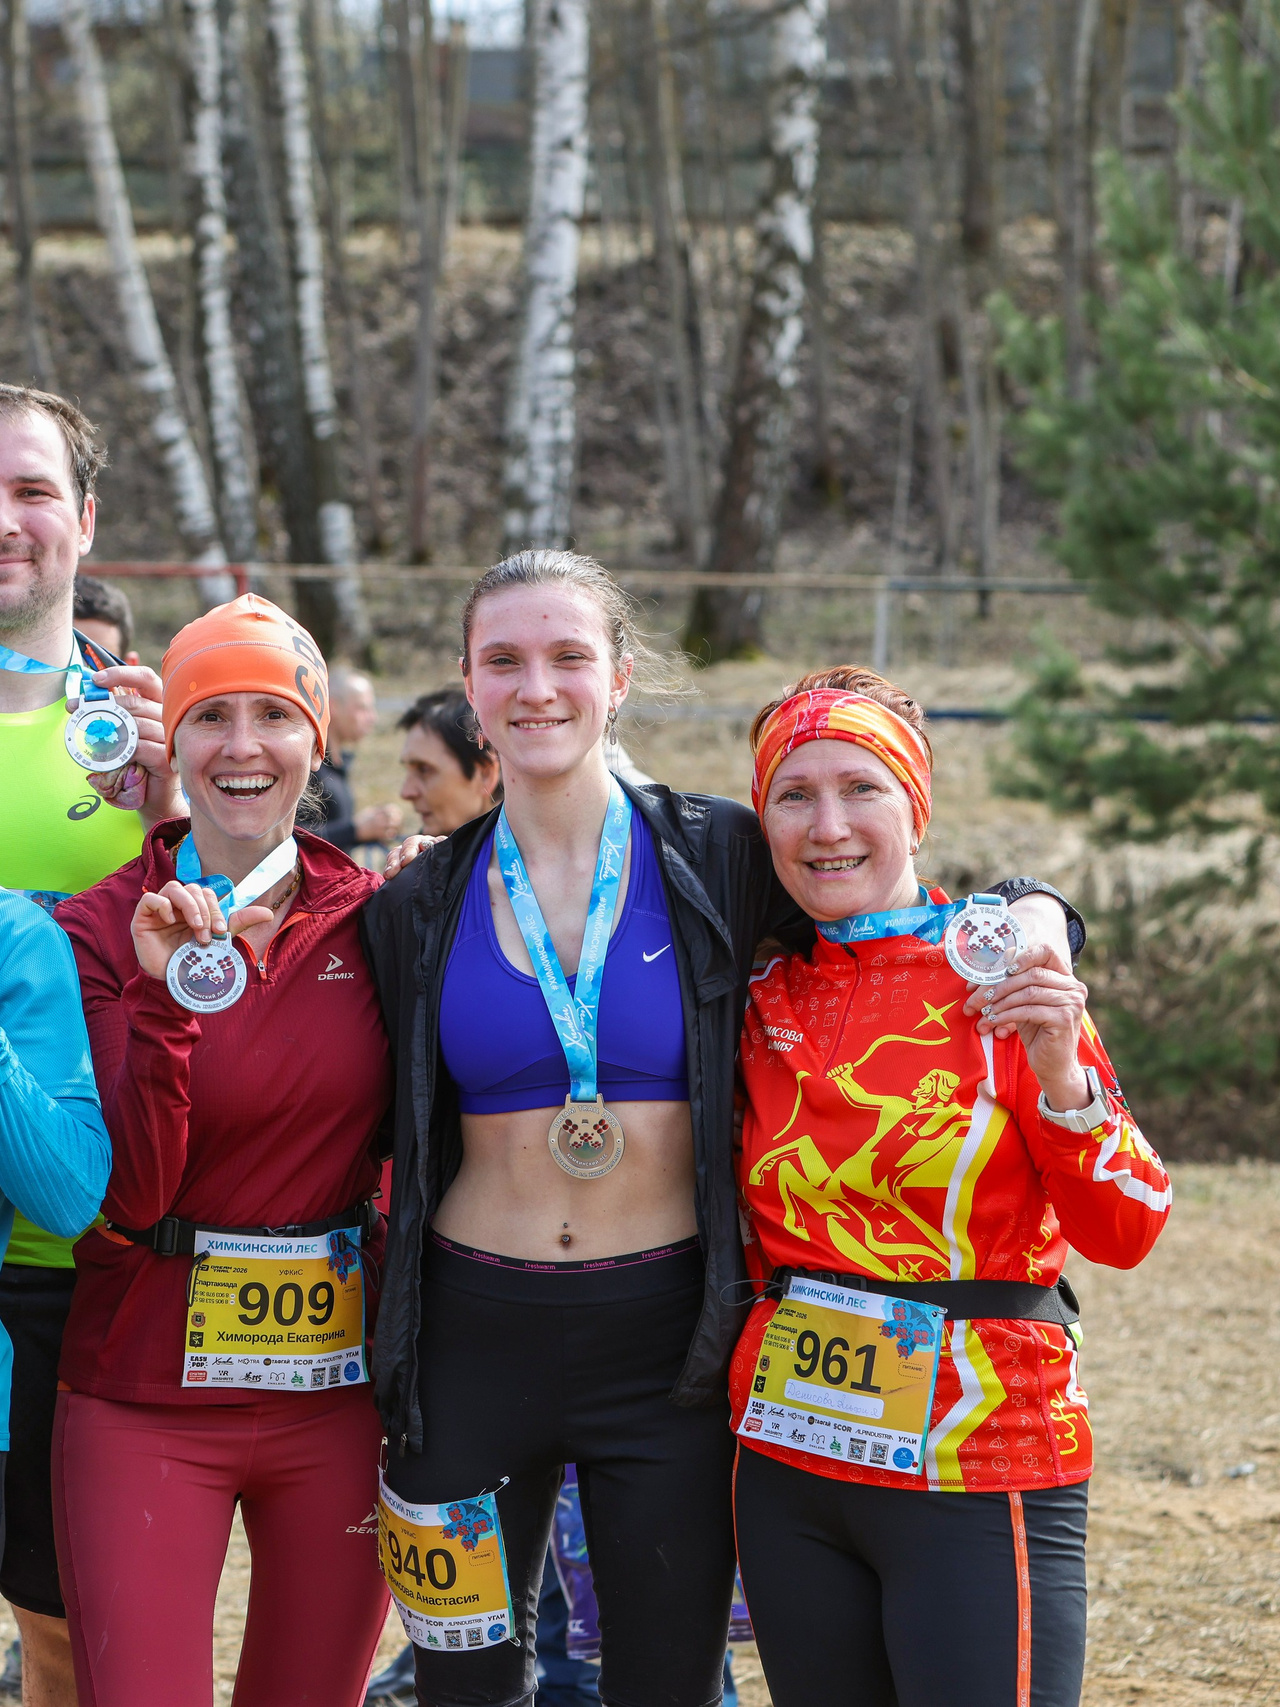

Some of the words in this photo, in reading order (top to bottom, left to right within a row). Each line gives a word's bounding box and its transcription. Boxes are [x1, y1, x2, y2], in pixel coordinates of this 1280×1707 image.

[207, 1240, 293, 1254] ХИМКИНСКИЙ
[295, 1243, 318, 1253] ЛЕС
[524, 1262, 556, 1270] freshwarm
[583, 1260, 616, 1269] freshwarm
[279, 1268, 303, 1276] УФКиС
[195, 1278, 238, 1288] Спартакиада
[791, 1284, 845, 1307] ХИМКИНСКИЙ
[846, 1296, 867, 1310] ЛЕС
[237, 1281, 335, 1327] 909
[770, 1321, 798, 1334] Спартакиада
[217, 1331, 284, 1346] Химорода
[287, 1329, 346, 1346] Екатерина
[794, 1330, 882, 1394] 961
[902, 1364, 923, 1372] ПИТАНИЕ
[833, 1423, 852, 1433] SCOR
[855, 1429, 894, 1441] ALPINDUSTRIA
[406, 1508, 424, 1520] ЛЕС
[388, 1530, 457, 1590] 940
[416, 1592, 480, 1606] Анастасия
[426, 1619, 444, 1627] SCOR
[447, 1618, 484, 1626] ALPINDUSTRIA
